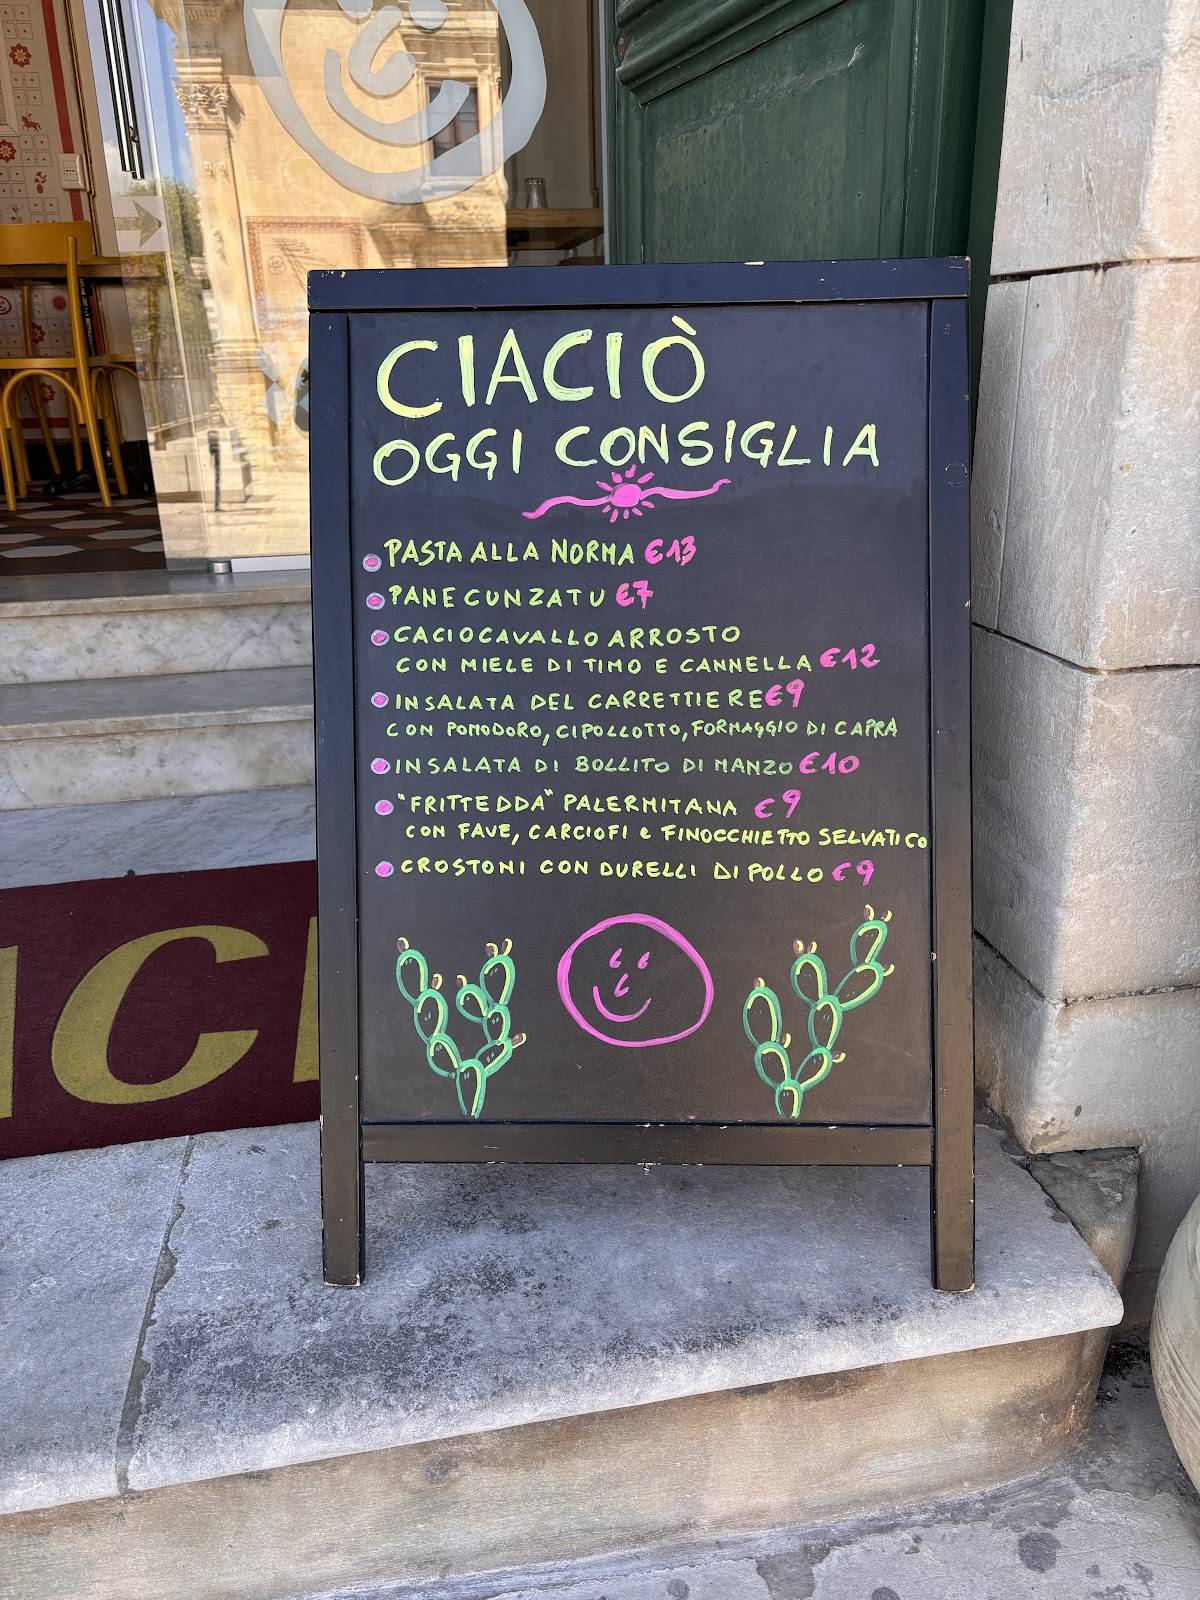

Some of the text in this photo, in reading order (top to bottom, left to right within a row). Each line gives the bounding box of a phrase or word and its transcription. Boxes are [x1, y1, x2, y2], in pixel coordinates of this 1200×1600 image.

[376, 316, 705, 420] CIACIÒ
[372, 420, 880, 486] OGGI CONSIGLIA
[384, 535, 697, 568] PASTA ALLA NORMA €13
[388, 579, 654, 609] PANE CUNZATU €7
[393, 625, 741, 648] CACIOCAVALLO ARROSTO
[395, 643, 879, 675] CON MIELE DI TIMO E CANNELLA €12
[395, 678, 805, 712] INSALATA DEL CARRETTIERE €9
[386, 722, 433, 738] CON
[806, 720, 826, 738] DI
[834, 718, 898, 738] CAPRA
[395, 751, 860, 776] INSALATA DI BOLLITO DI MANZO €10
[563, 793, 737, 818] PALERMITANA
[405, 823, 446, 840] CON
[457, 822, 520, 847] FAVE,
[528, 822, 628, 841] CARCIOFI
[660, 824, 811, 850] FINOCCHIETTO
[818, 826, 928, 850] SELVATICO
[400, 857, 526, 877] CROSTONI
[539, 859, 589, 875] CON
[599, 859, 697, 880] DURELLI
[712, 861, 739, 880] DI
[747, 862, 826, 886] POLLO
